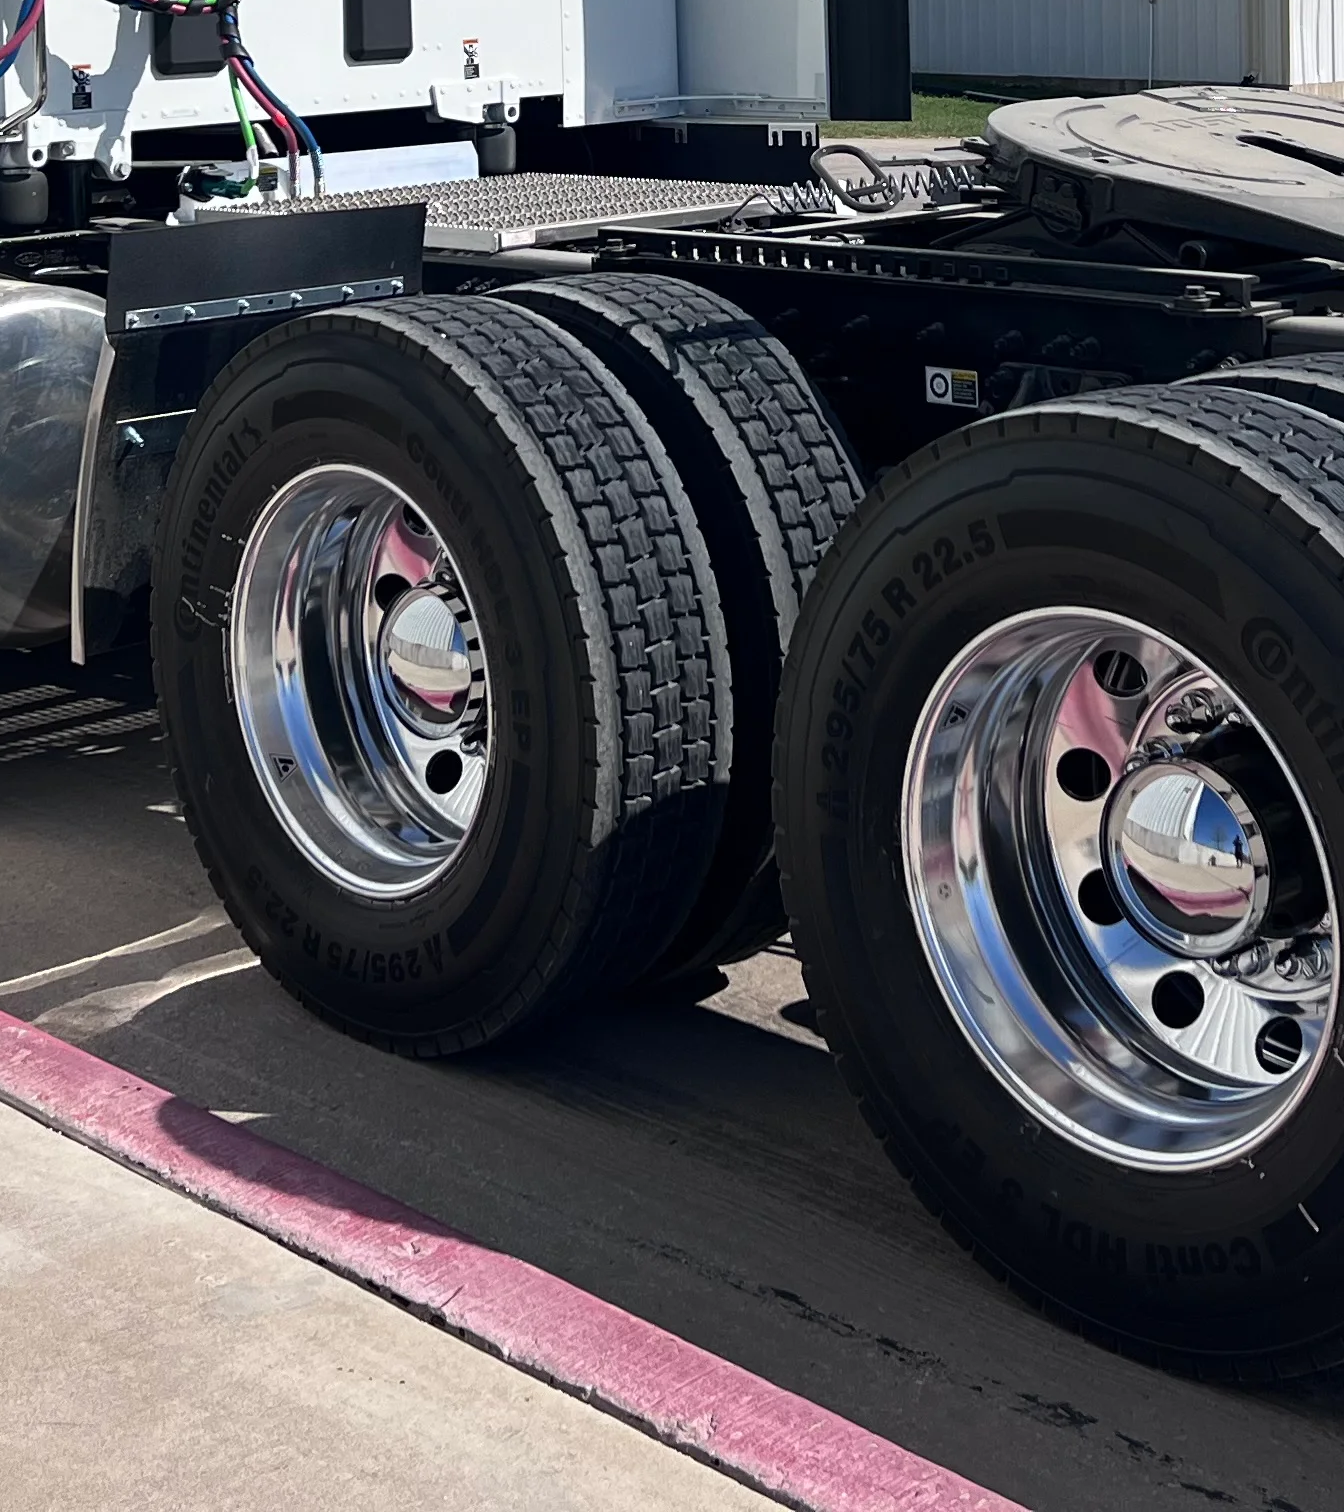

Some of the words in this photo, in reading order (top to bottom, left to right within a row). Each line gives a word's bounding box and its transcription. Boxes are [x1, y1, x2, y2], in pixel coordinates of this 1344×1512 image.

[174, 433, 248, 642] Continental
[823, 609, 890, 773] 295/75
[882, 577, 916, 619] R
[913, 519, 996, 592] 22.5
[303, 925, 322, 962] R
